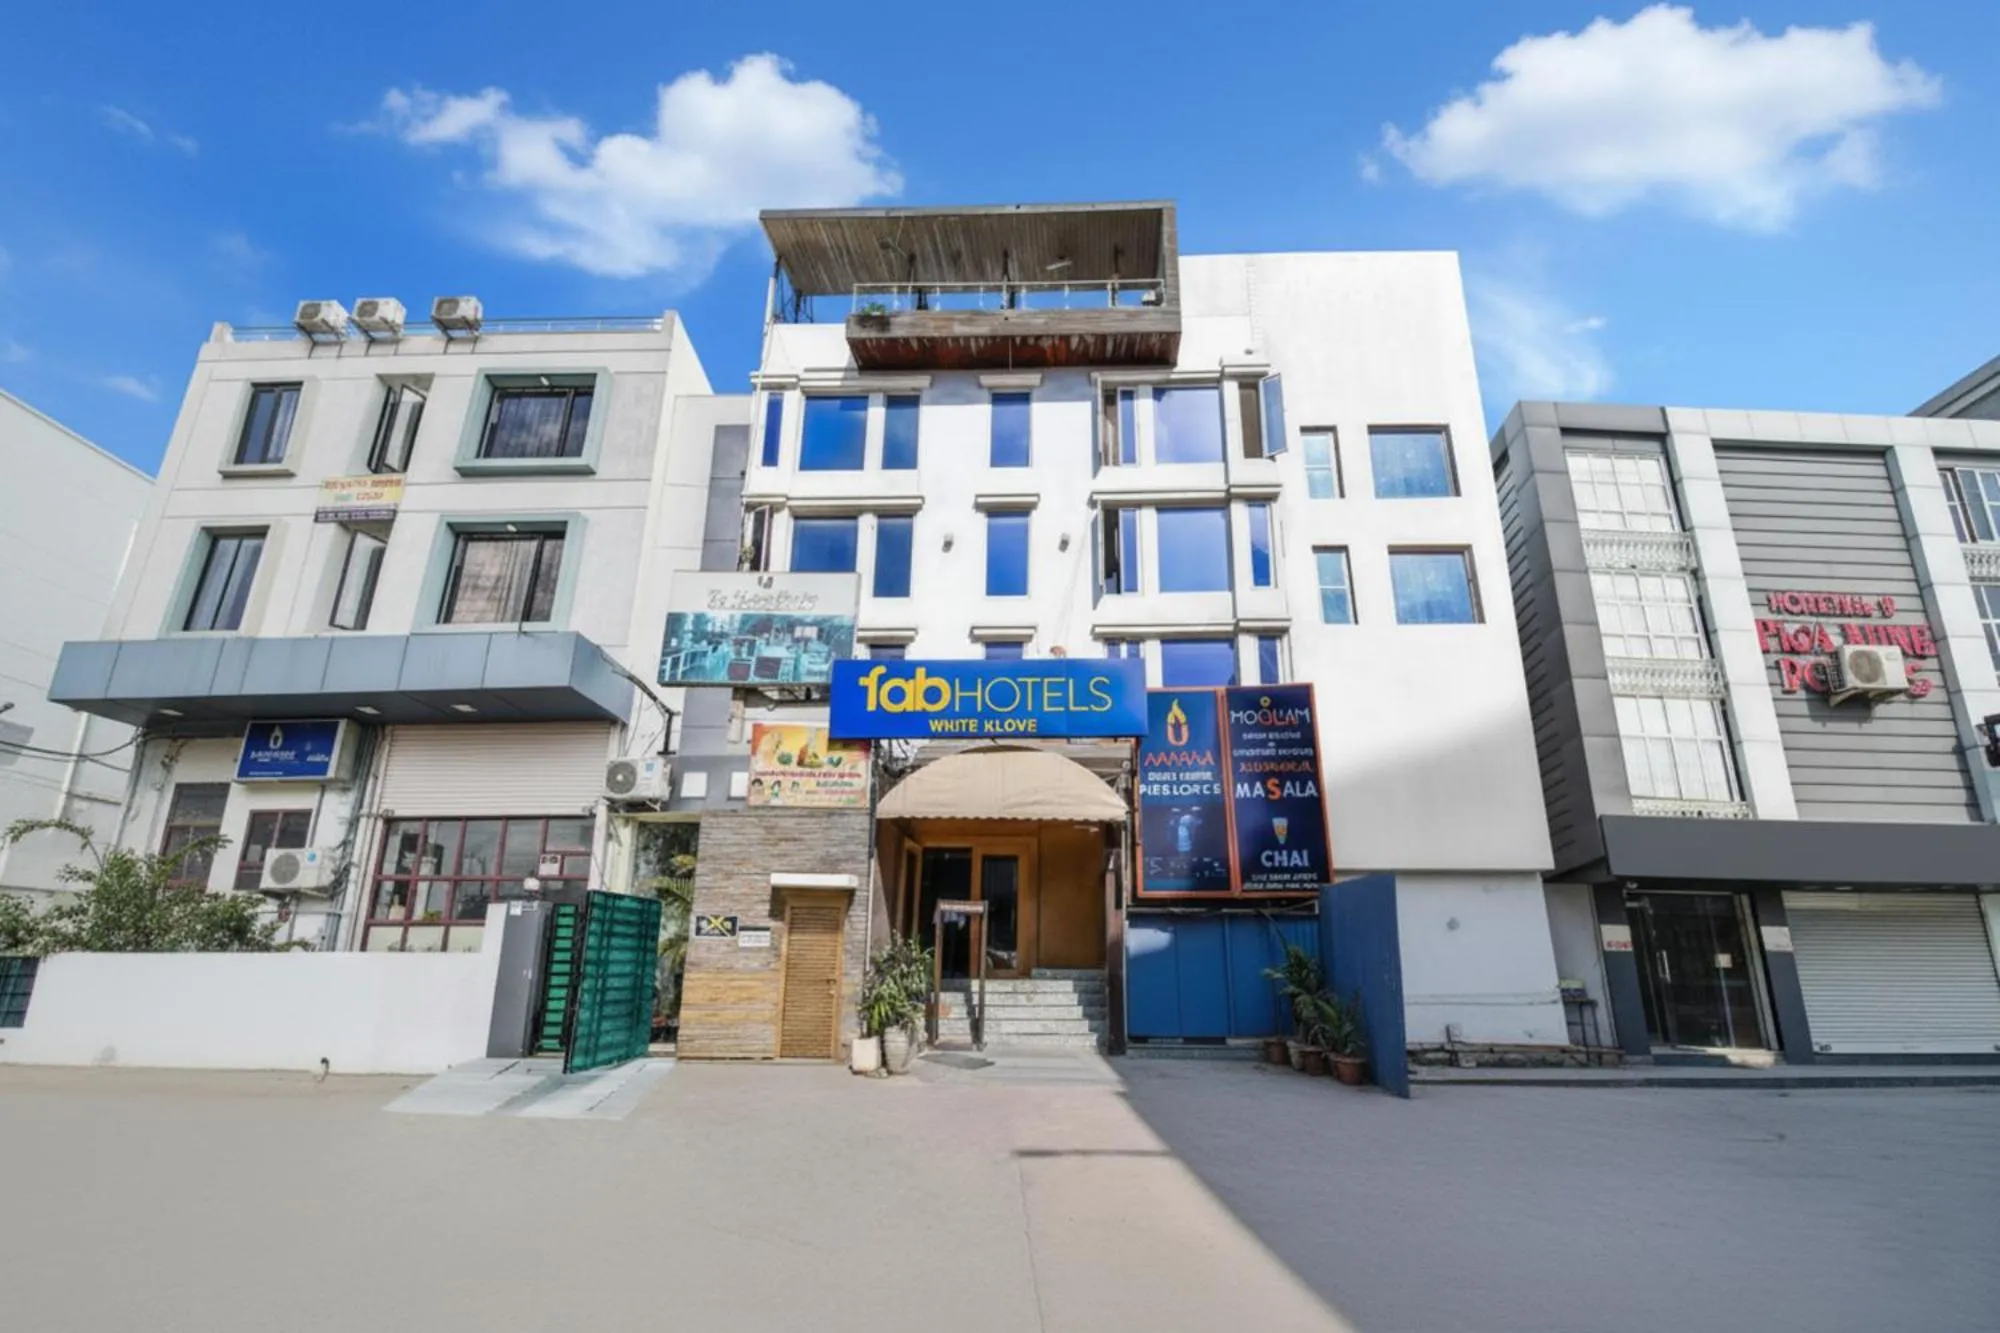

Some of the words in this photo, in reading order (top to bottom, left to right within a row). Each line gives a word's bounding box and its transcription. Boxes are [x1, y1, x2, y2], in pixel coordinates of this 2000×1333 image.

[859, 665, 1112, 713] fabHOTELS
[929, 719, 979, 732] WHITE
[984, 718, 1038, 732] KLOVE
[1236, 778, 1318, 800] MASALA
[1261, 849, 1309, 867] CHAI
